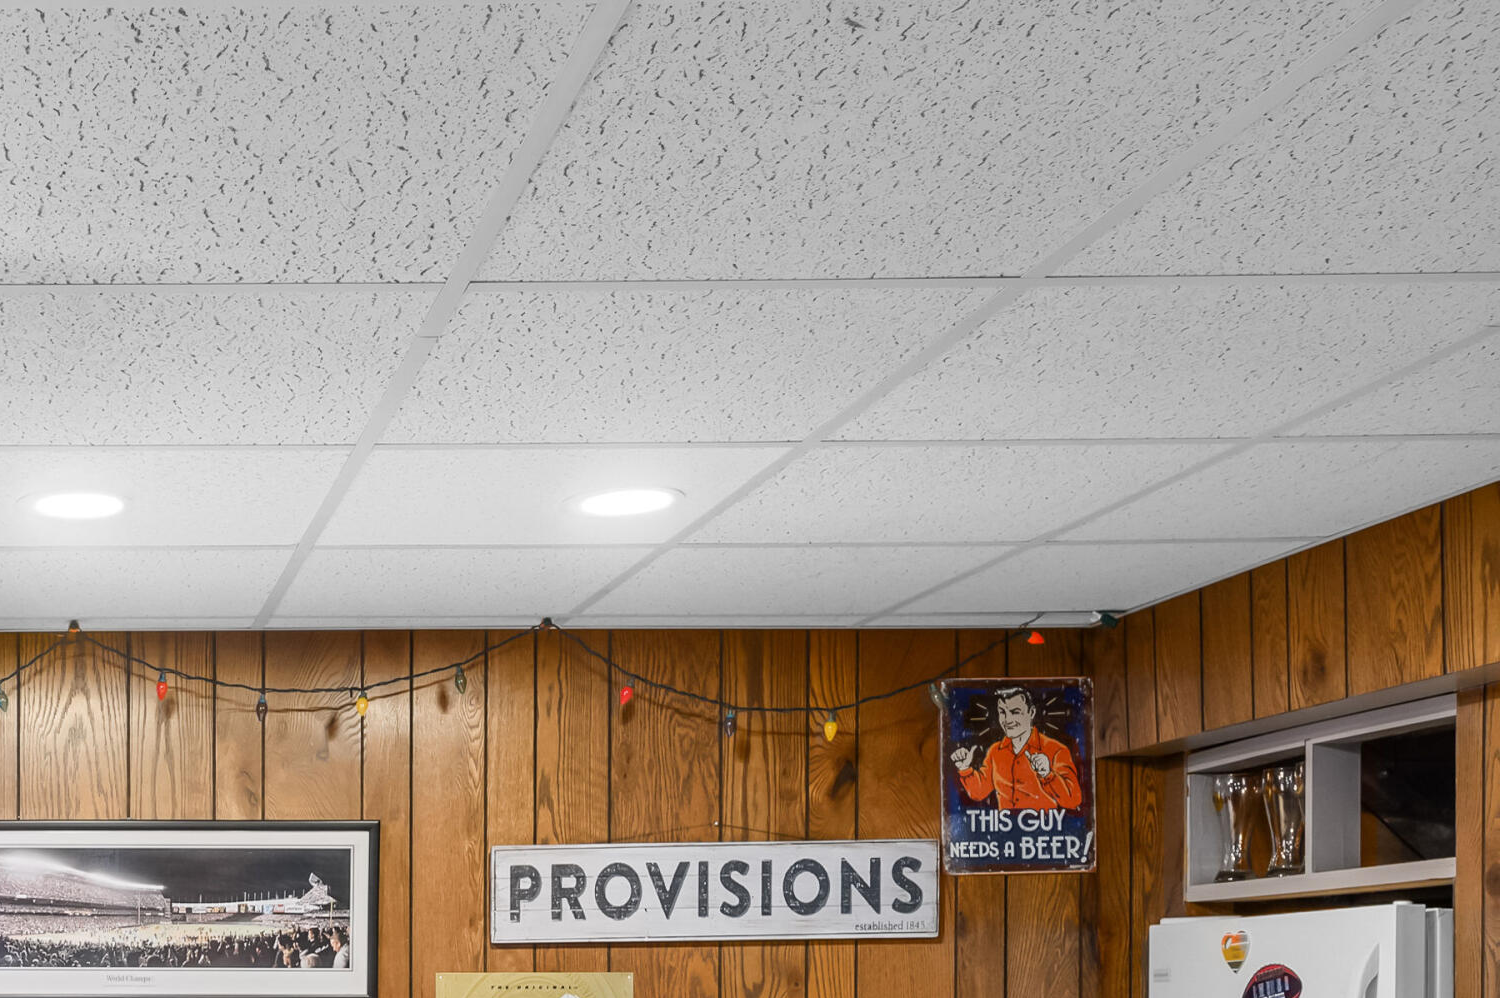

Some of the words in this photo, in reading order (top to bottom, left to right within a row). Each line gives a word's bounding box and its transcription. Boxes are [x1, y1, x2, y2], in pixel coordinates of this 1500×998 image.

[966, 809, 1013, 832] THIS
[1017, 809, 1066, 832] GUY
[950, 841, 999, 858] NEEDS
[1004, 842, 1015, 857] A
[1020, 831, 1093, 863] BEER!
[509, 856, 924, 922] PROVISIONS
[855, 921, 903, 931] established
[906, 920, 925, 930] 1845
